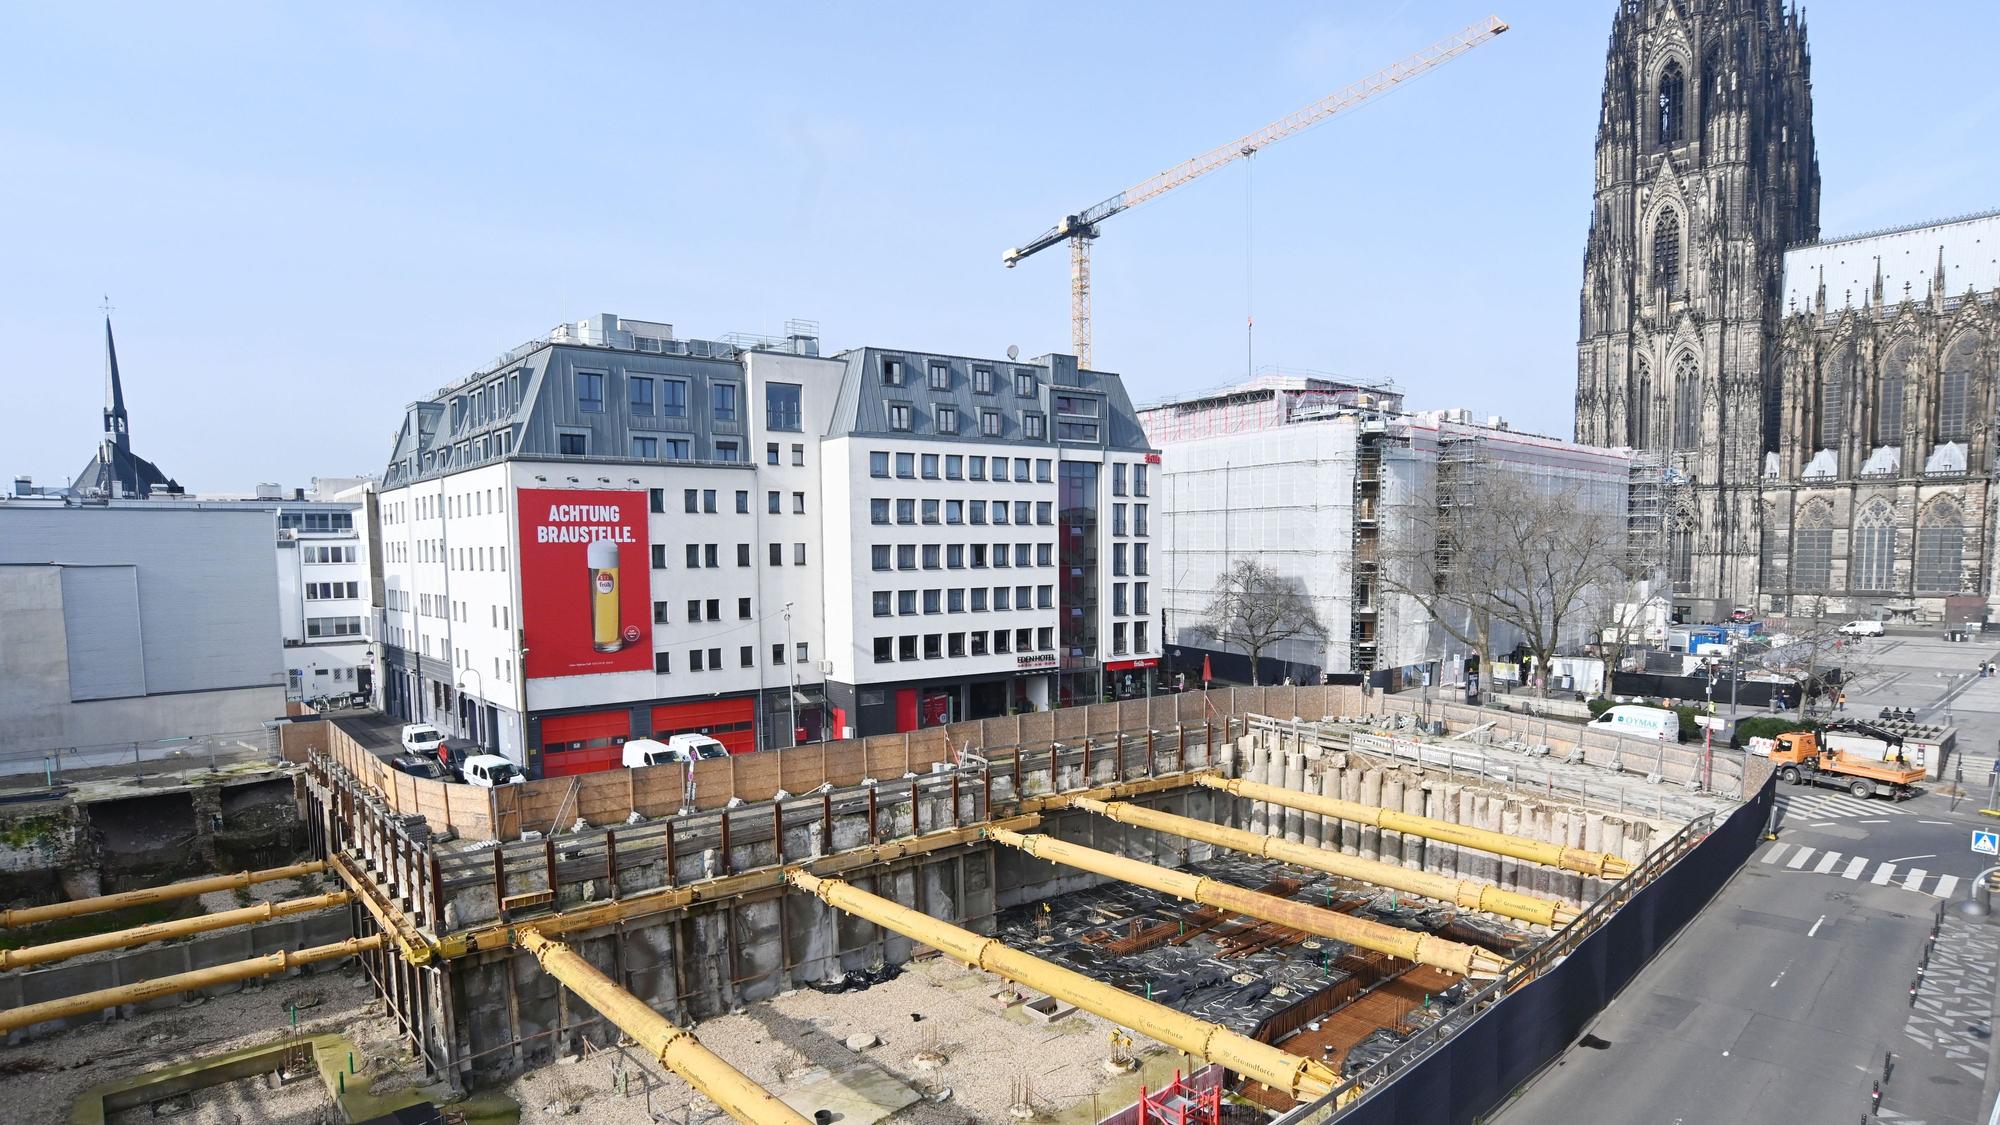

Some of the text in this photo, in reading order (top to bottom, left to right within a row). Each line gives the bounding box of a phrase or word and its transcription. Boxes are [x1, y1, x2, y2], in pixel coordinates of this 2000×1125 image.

[548, 504, 620, 522] ACHTUNG
[537, 526, 636, 543] BRAUSTELLE.
[1232, 1055, 1275, 1078] Groundforce
